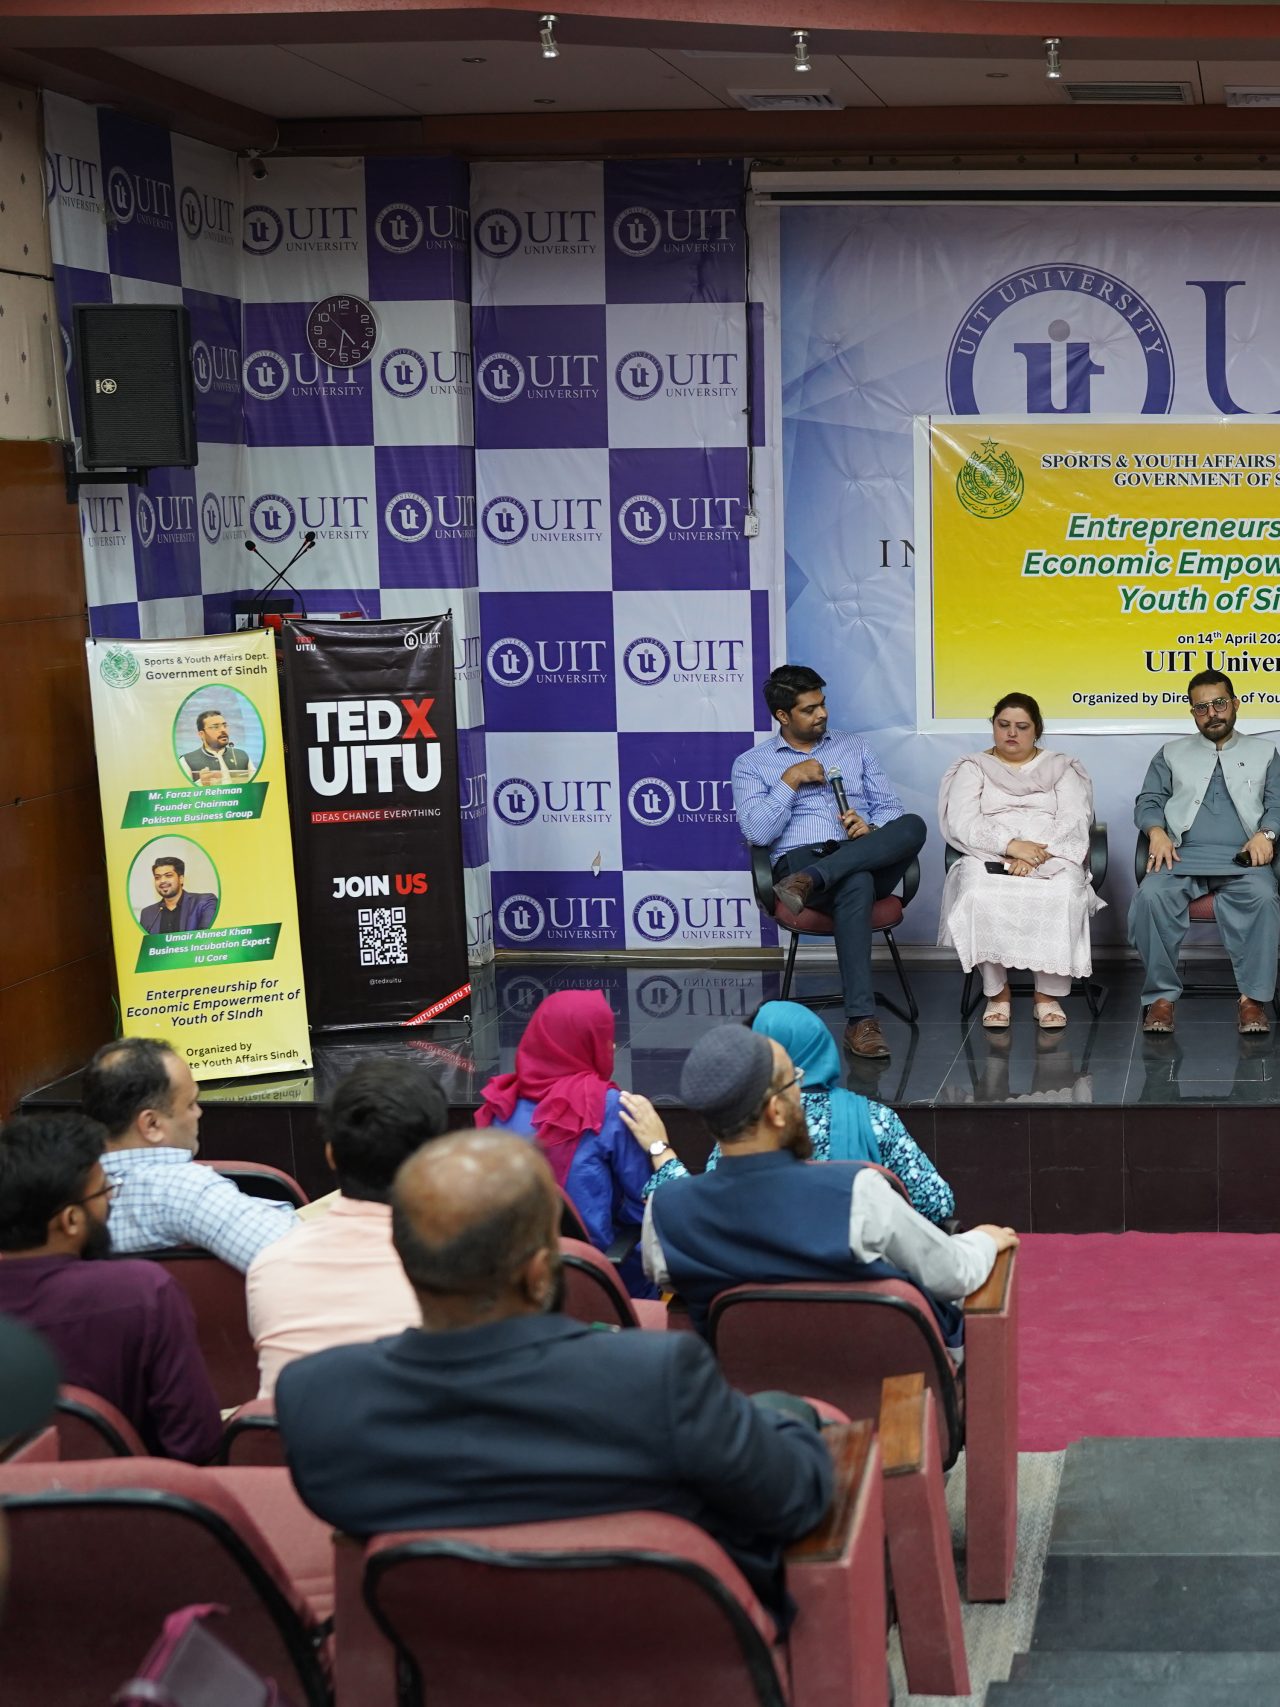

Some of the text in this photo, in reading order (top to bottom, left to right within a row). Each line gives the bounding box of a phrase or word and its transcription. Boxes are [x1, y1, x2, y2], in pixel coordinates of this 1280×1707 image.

[287, 207, 358, 239] UIT
[524, 211, 596, 242] UIT
[663, 209, 736, 241] UIT
[286, 241, 358, 252] UNIVERSITY
[524, 245, 596, 255] UNIVERSITY
[663, 242, 736, 253] UNIVERSITY
[957, 270, 1166, 358] UIT UNIVERSITY
[1042, 455, 1112, 468] SPORTS
[1116, 455, 1128, 468] &
[1134, 455, 1198, 468] YOUTH
[1203, 455, 1276, 468] AFFAIRS
[1114, 473, 1242, 487] GOVERNMENT
[1247, 473, 1271, 487] OF
[1023, 551, 1172, 577] Economic
[1119, 588, 1207, 612] Youth
[1216, 587, 1246, 612] of
[419, 633, 440, 644] UIT
[1178, 634, 1194, 644] on
[1225, 633, 1257, 645] April
[144, 657, 174, 667] Sports
[184, 656, 211, 664] Youth
[213, 654, 243, 662] Affairs
[245, 653, 269, 663] Dept.
[535, 640, 606, 672] UIT
[1145, 651, 1197, 672] UIT
[146, 665, 268, 680] Government of Sindh
[536, 674, 608, 684] UNIVERSITY
[1072, 692, 1138, 705] Organized
[1142, 692, 1158, 705] by
[1241, 692, 1254, 703] of
[306, 698, 437, 742] TEDX
[308, 743, 442, 796] UITU
[149, 792, 164, 800] Mr.
[166, 790, 192, 799] Faraz
[205, 787, 242, 796] Rehman
[154, 799, 239, 812] Founder Chairman
[142, 810, 253, 825] Pakistan Business Group
[312, 809, 441, 822] IDEAS CHANGE EVERYTHING
[332, 873, 428, 898] JOIN US
[681, 898, 751, 928] UIT
[165, 927, 252, 942] Umair Ahmed Khan
[682, 930, 752, 939] UNIVERSITY
[149, 937, 270, 956] Business Incubation Expert
[146, 978, 279, 1001] Enterpreneurship for
[127, 989, 301, 1017] Economic Empowerment of
[171, 1014, 207, 1027] Youth
[211, 1011, 224, 1022] of
[186, 1042, 252, 1058] Organized by
[202, 1057, 232, 1068] Youth
[235, 1054, 268, 1064] Affairs
[270, 1050, 298, 1060] Sindh
